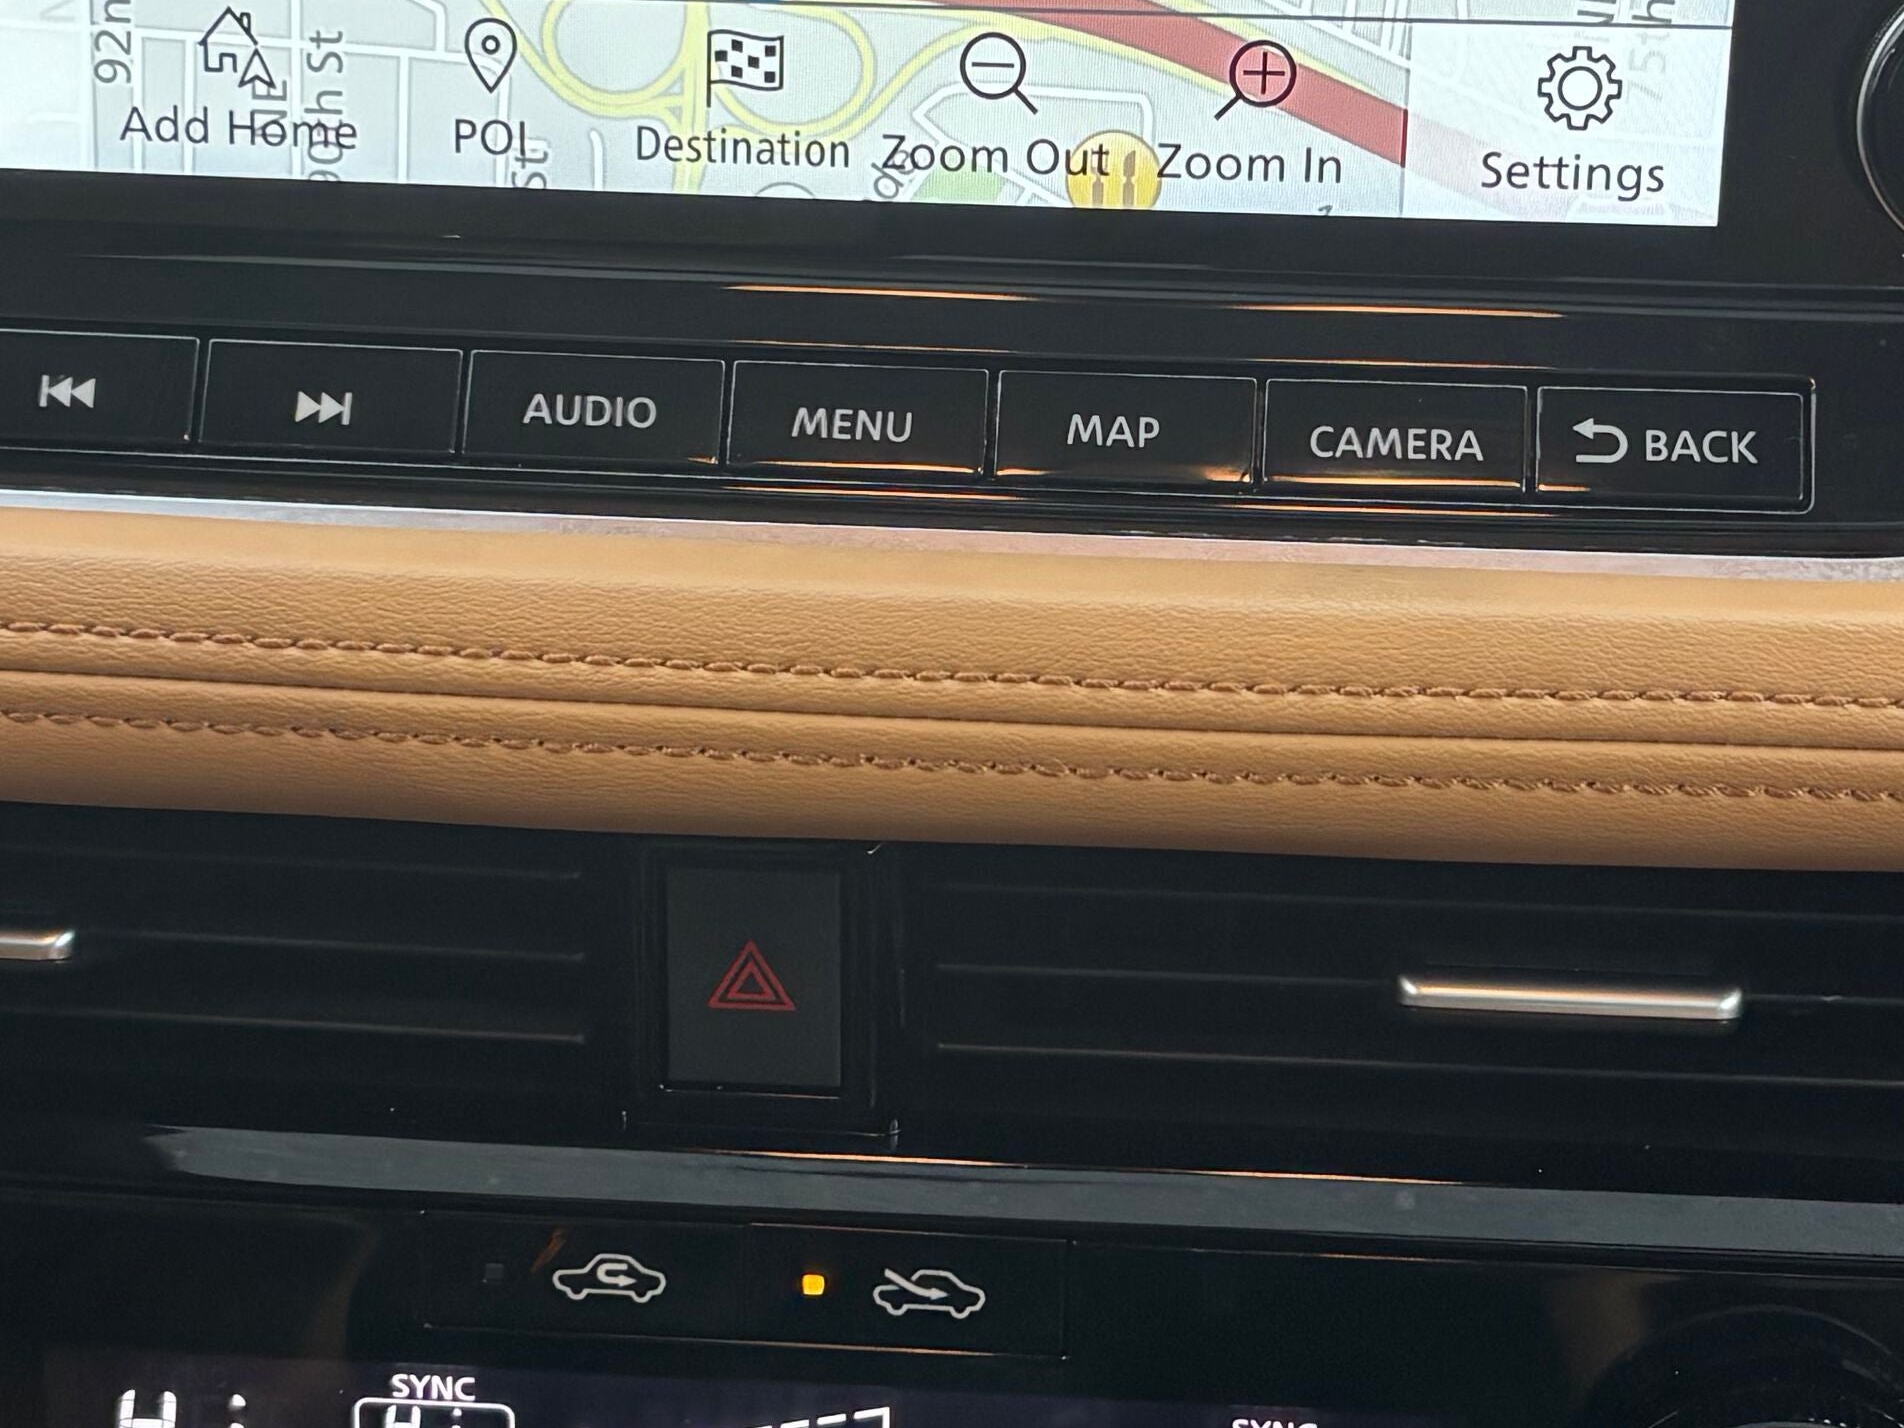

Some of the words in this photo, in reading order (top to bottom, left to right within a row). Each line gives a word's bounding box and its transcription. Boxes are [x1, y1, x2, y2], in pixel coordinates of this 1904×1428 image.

[305, 29, 345, 73] St
[119, 104, 209, 144] Add
[228, 109, 358, 151] Home
[453, 118, 526, 158] POI
[636, 125, 851, 170] Destination
[881, 133, 1009, 173] Zoom
[1026, 137, 1111, 177] Out
[1157, 143, 1284, 183] Zoom
[1304, 147, 1343, 185] In
[1480, 151, 1666, 202] Settings
[521, 391, 658, 430] AUDIO
[790, 404, 915, 445] MENU
[1066, 412, 1162, 451] MAP
[1309, 424, 1486, 464] CAMERA
[1643, 428, 1760, 466] BACK
[391, 1373, 477, 1403] SYNC
